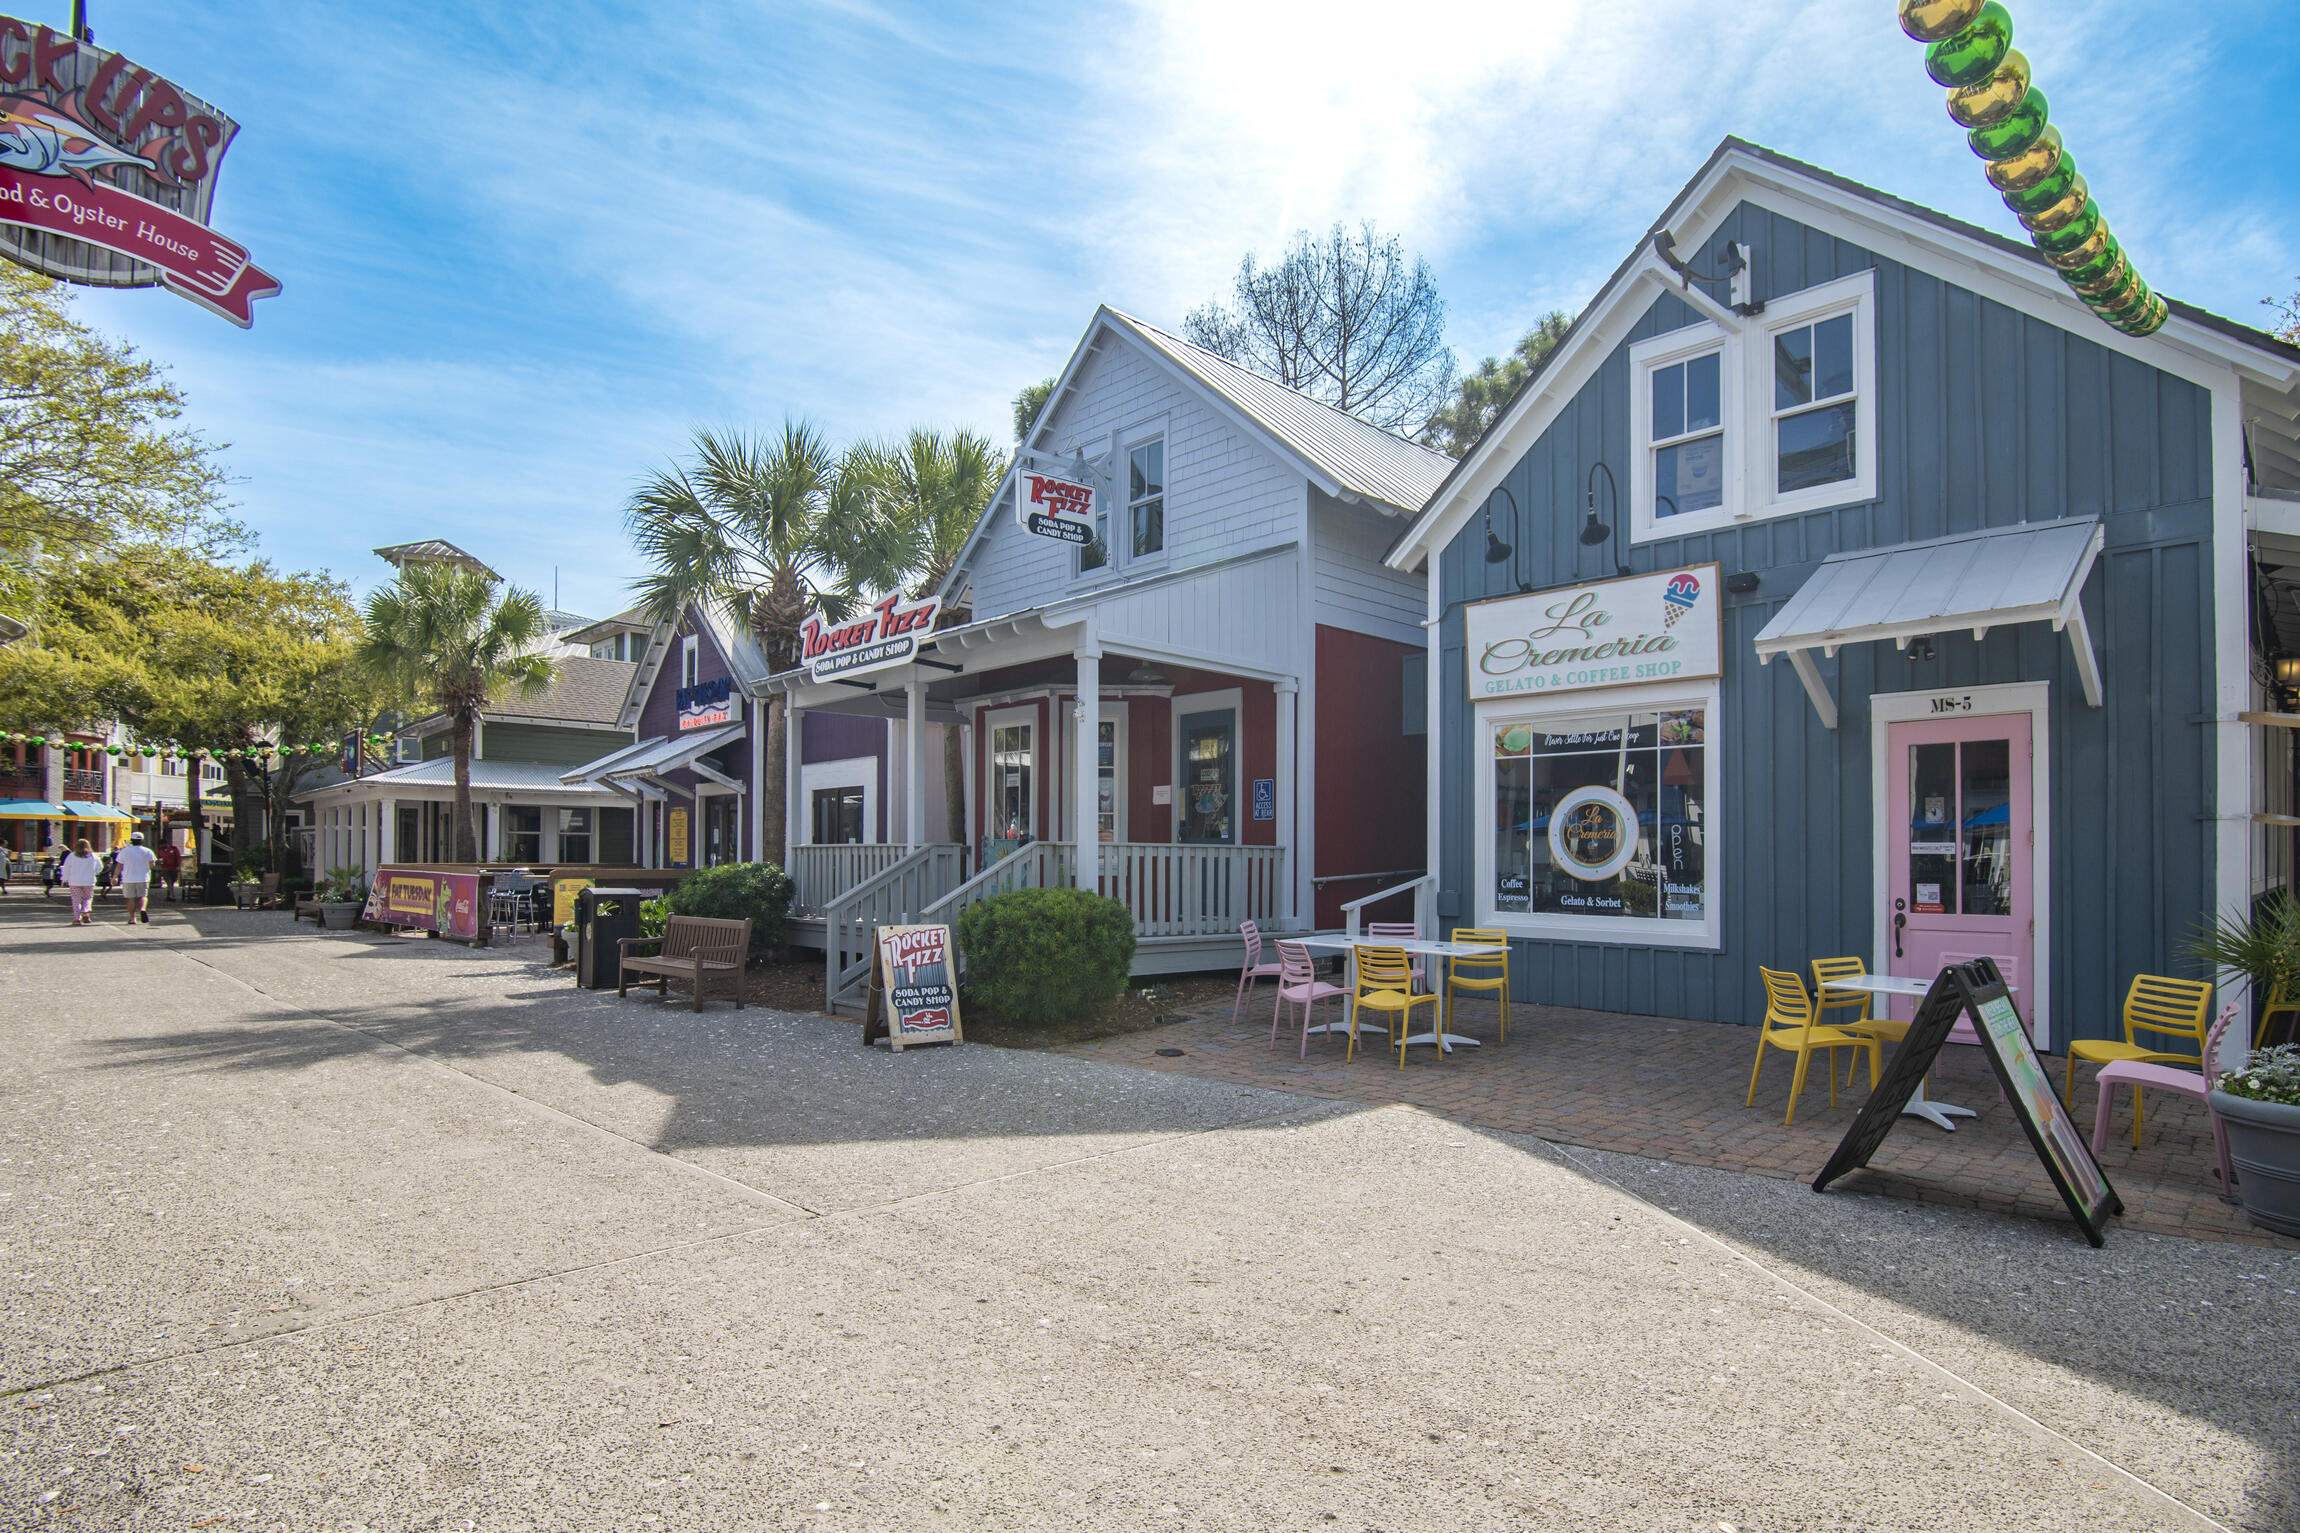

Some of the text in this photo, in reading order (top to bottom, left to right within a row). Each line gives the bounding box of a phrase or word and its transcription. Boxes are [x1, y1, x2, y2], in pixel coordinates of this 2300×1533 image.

[30, 187, 50, 208] &
[54, 194, 129, 231] Oyster
[136, 220, 199, 261] House
[1024, 475, 1093, 504] ROCKET
[1041, 496, 1091, 519] FIZZ
[1037, 526, 1084, 541] CANDY SHOP
[1038, 517, 1059, 528] SODA
[1060, 522, 1076, 532] POP
[1529, 591, 1613, 640] La
[802, 594, 936, 659] ROCKET FIZZ
[816, 639, 910, 673] SODA POP & CANDY SHOP
[1480, 633, 1681, 675] Cremeria
[1485, 660, 1682, 694] GELATO & COFFEE SHOP
[1930, 695, 1972, 713] MS-5
[1256, 801, 1272, 809] ACCESS
[1582, 806, 1603, 825] La
[1567, 823, 1617, 840] Cremeria
[1501, 878, 1524, 888] Coffee
[1663, 883, 1701, 894] Milkshakes
[1498, 892, 1529, 903] Espresso
[1560, 895, 1622, 908] Gelato & Sorbet
[1665, 901, 1700, 912] Smoothies
[882, 928, 946, 969] ROCKET
[900, 947, 943, 985] FIZZ
[895, 985, 948, 998] SODA POP &
[895, 994, 951, 1007] CANDY SHOP
